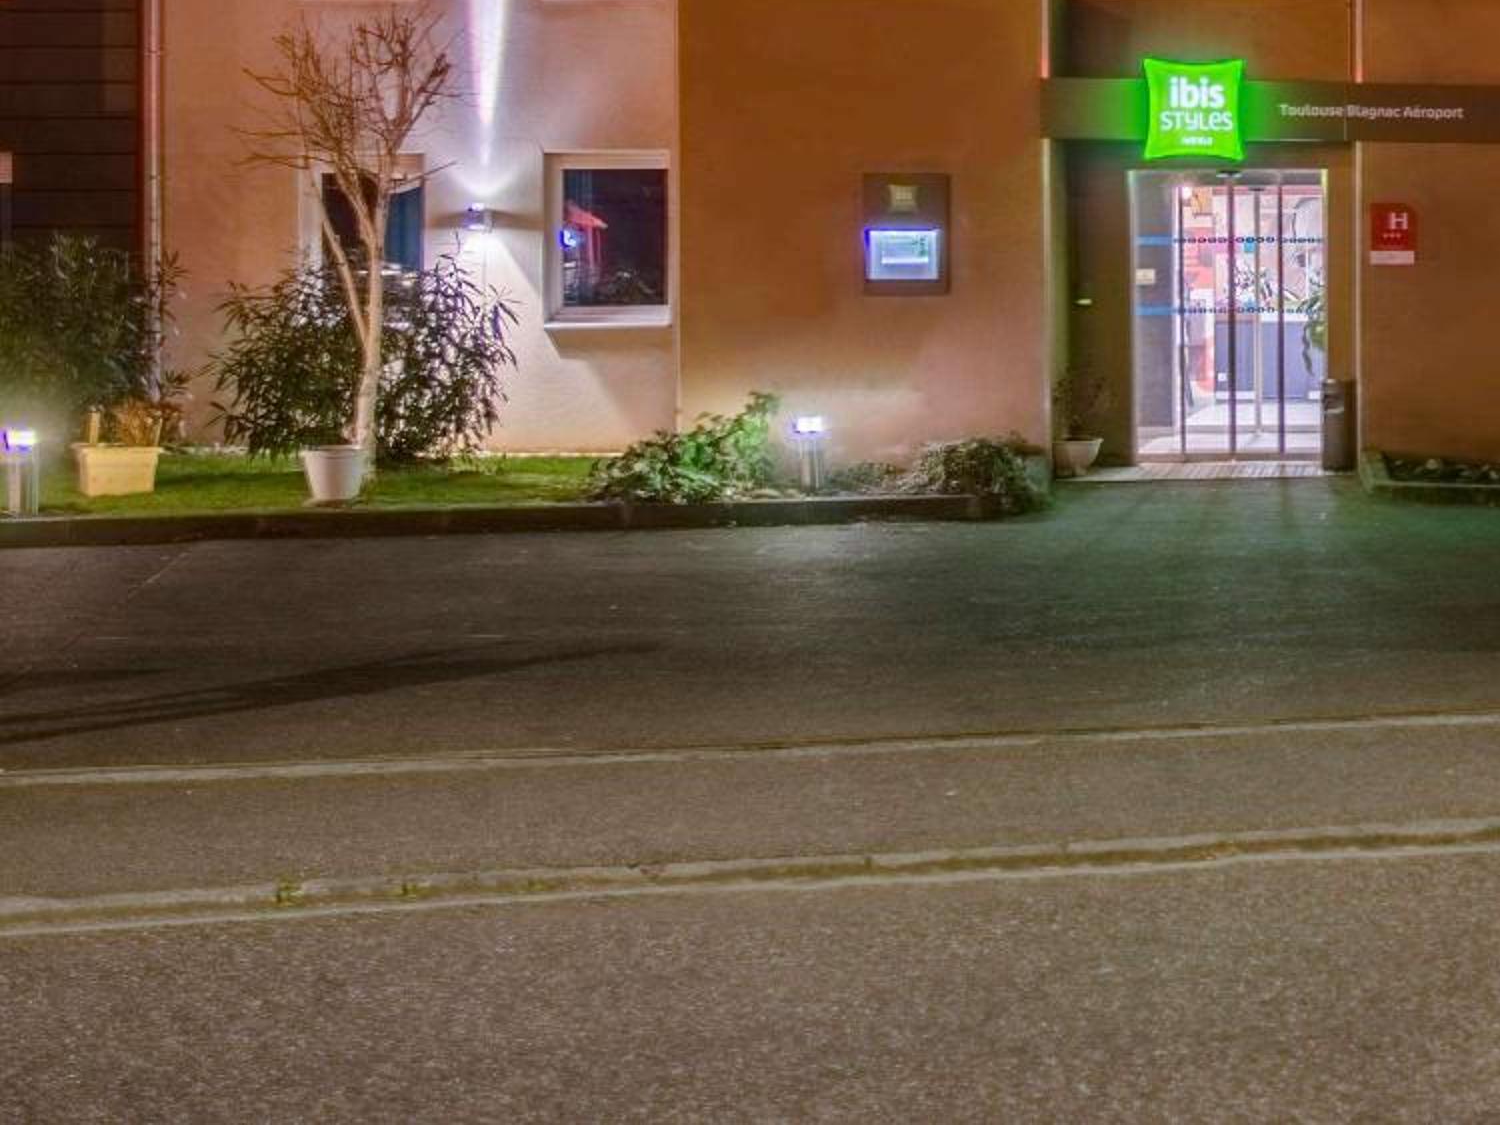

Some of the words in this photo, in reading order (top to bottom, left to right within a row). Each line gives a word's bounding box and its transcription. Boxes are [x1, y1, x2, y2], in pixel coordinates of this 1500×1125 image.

[1169, 76, 1225, 108] ibis
[1279, 103, 1343, 118] Toulouse
[1346, 104, 1401, 121] Blagnac
[1391, 212, 1408, 230] H
